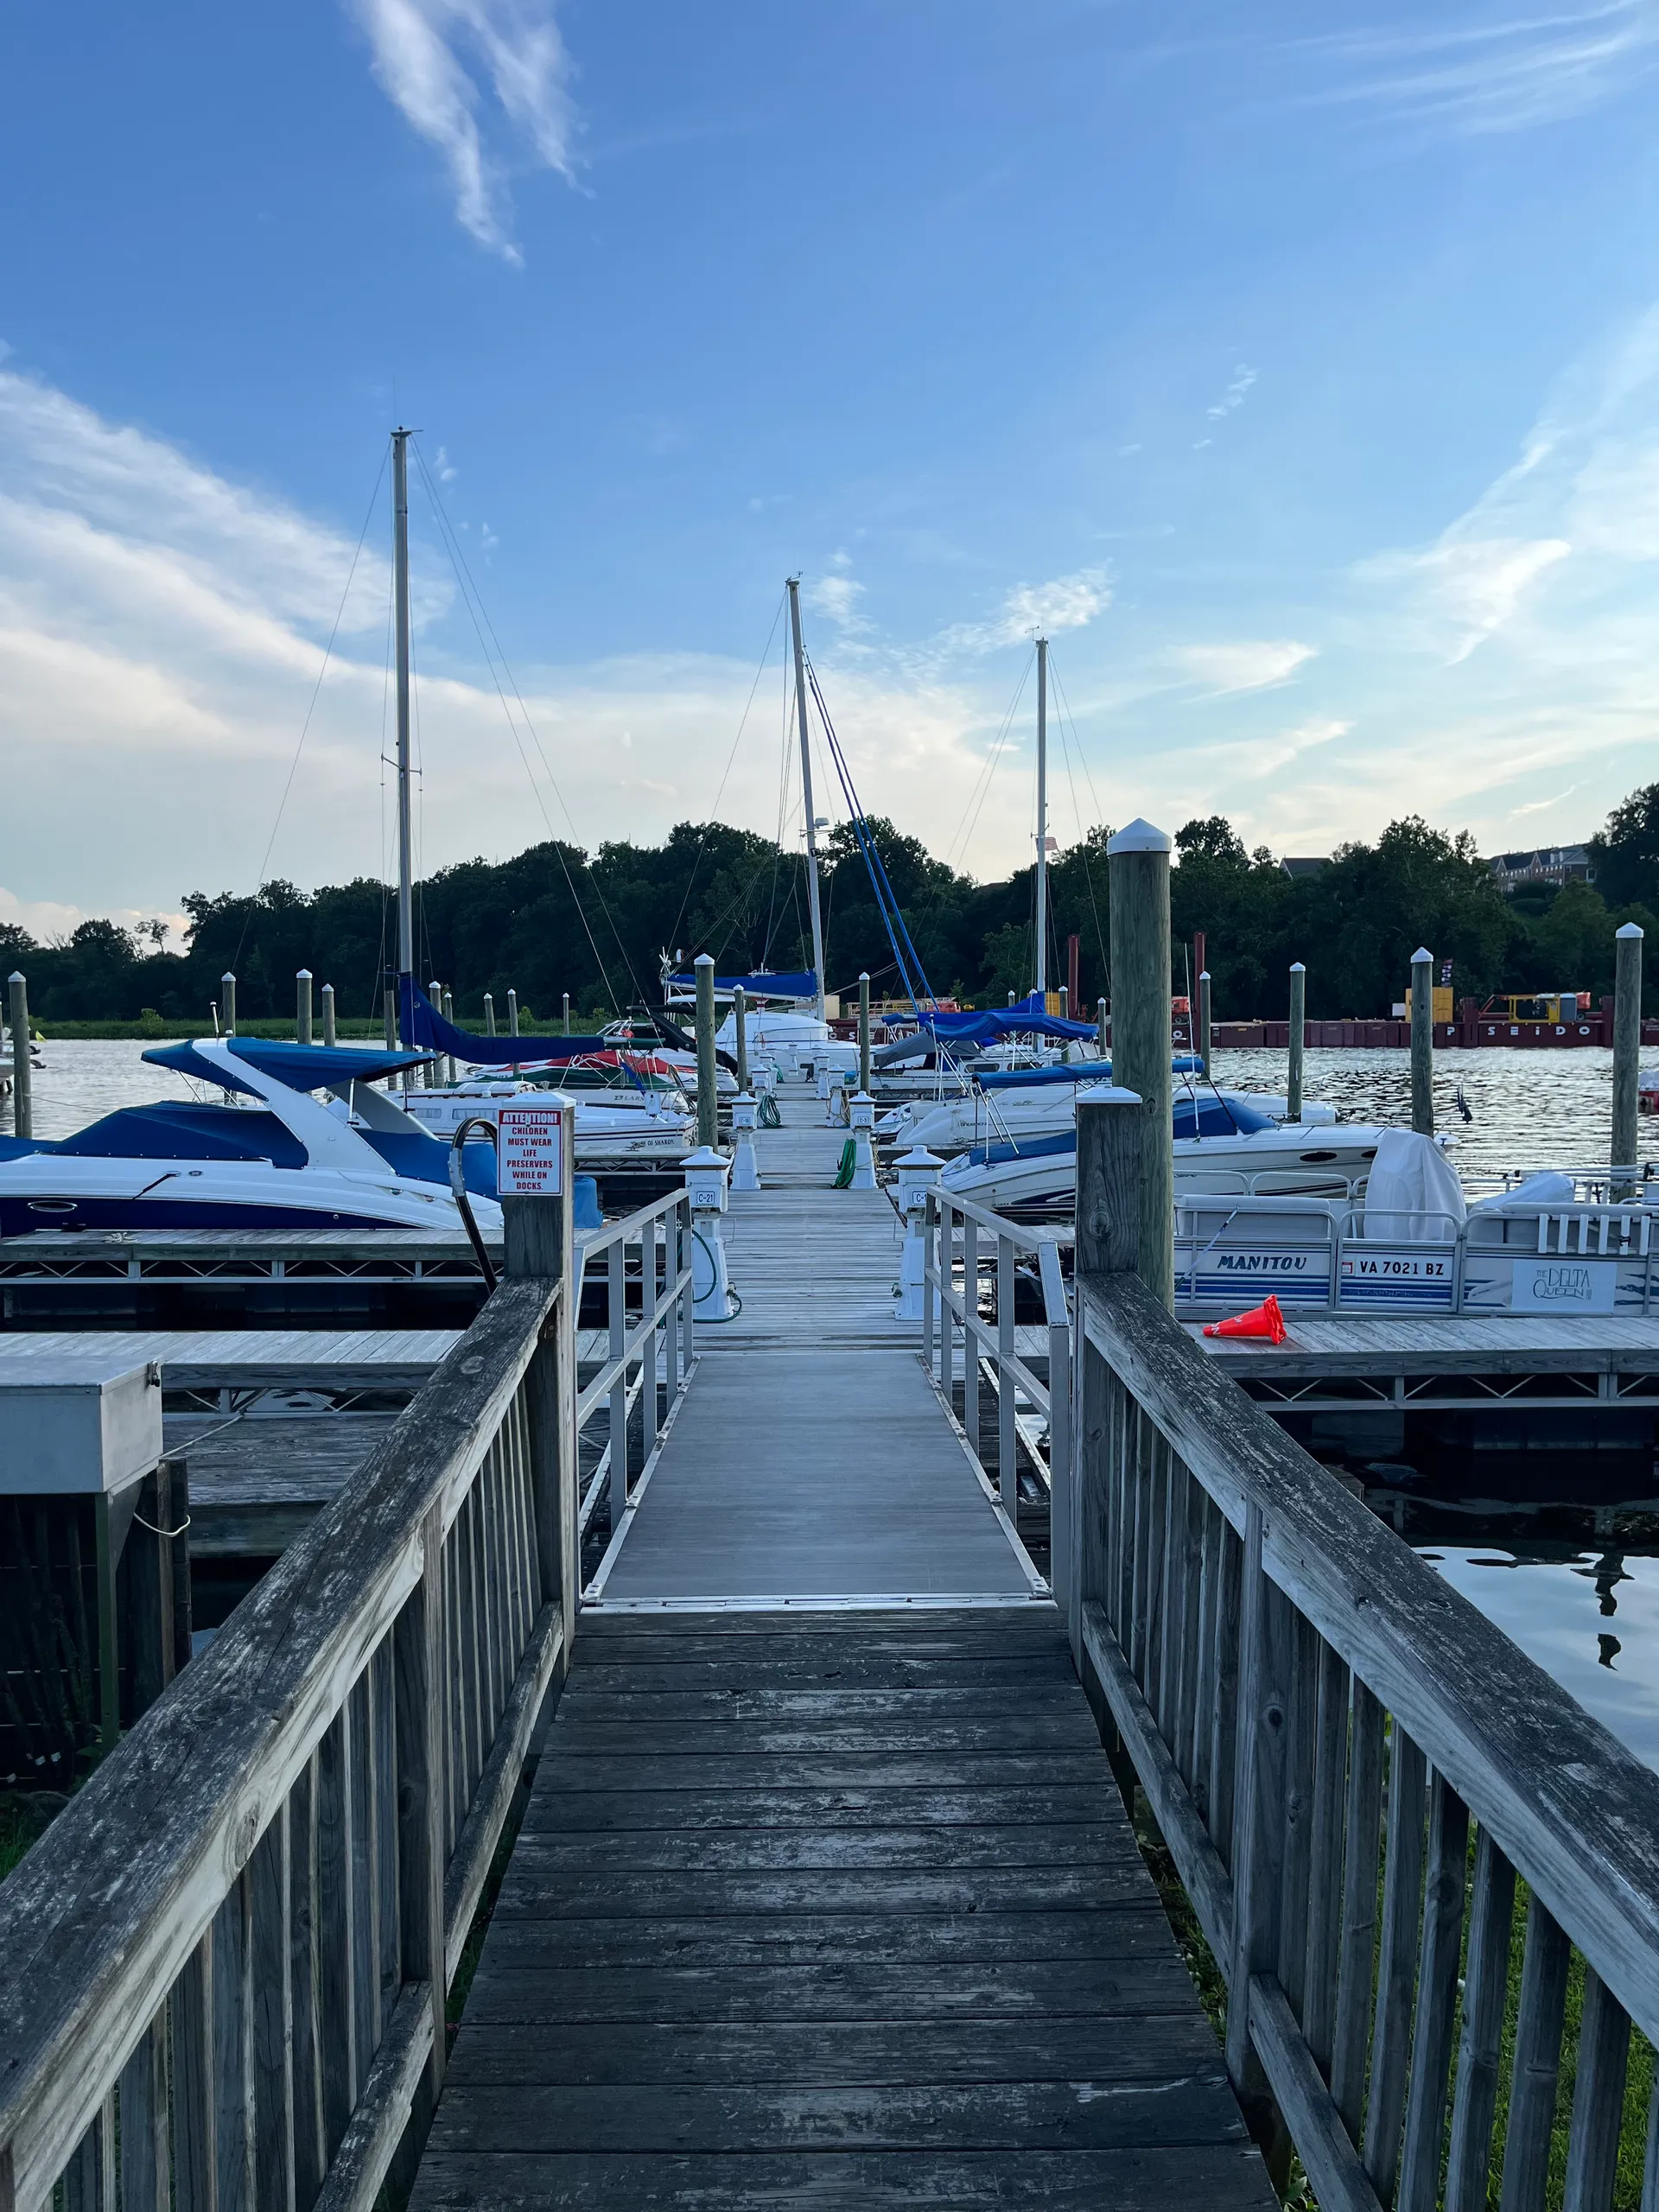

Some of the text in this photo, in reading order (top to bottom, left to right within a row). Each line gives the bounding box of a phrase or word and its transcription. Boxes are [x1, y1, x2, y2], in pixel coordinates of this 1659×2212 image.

[502, 1112, 558, 1124] ATTENTION!
[512, 1127, 549, 1135] CHILDREN
[507, 1138, 552, 1147] MUST WEAR
[523, 1148, 537, 1157] LIFE
[506, 1160, 553, 1168] PRESERVERS
[512, 1171, 536, 1179] WHILE
[516, 1181, 543, 1191] DOCKS.
[698, 1193, 714, 1203] C-21
[1217, 1255, 1307, 1271] MANITOU
[1360, 1261, 1444, 1275] VA 7021 BZ
[1535, 1268, 1590, 1287] THE DELTA
